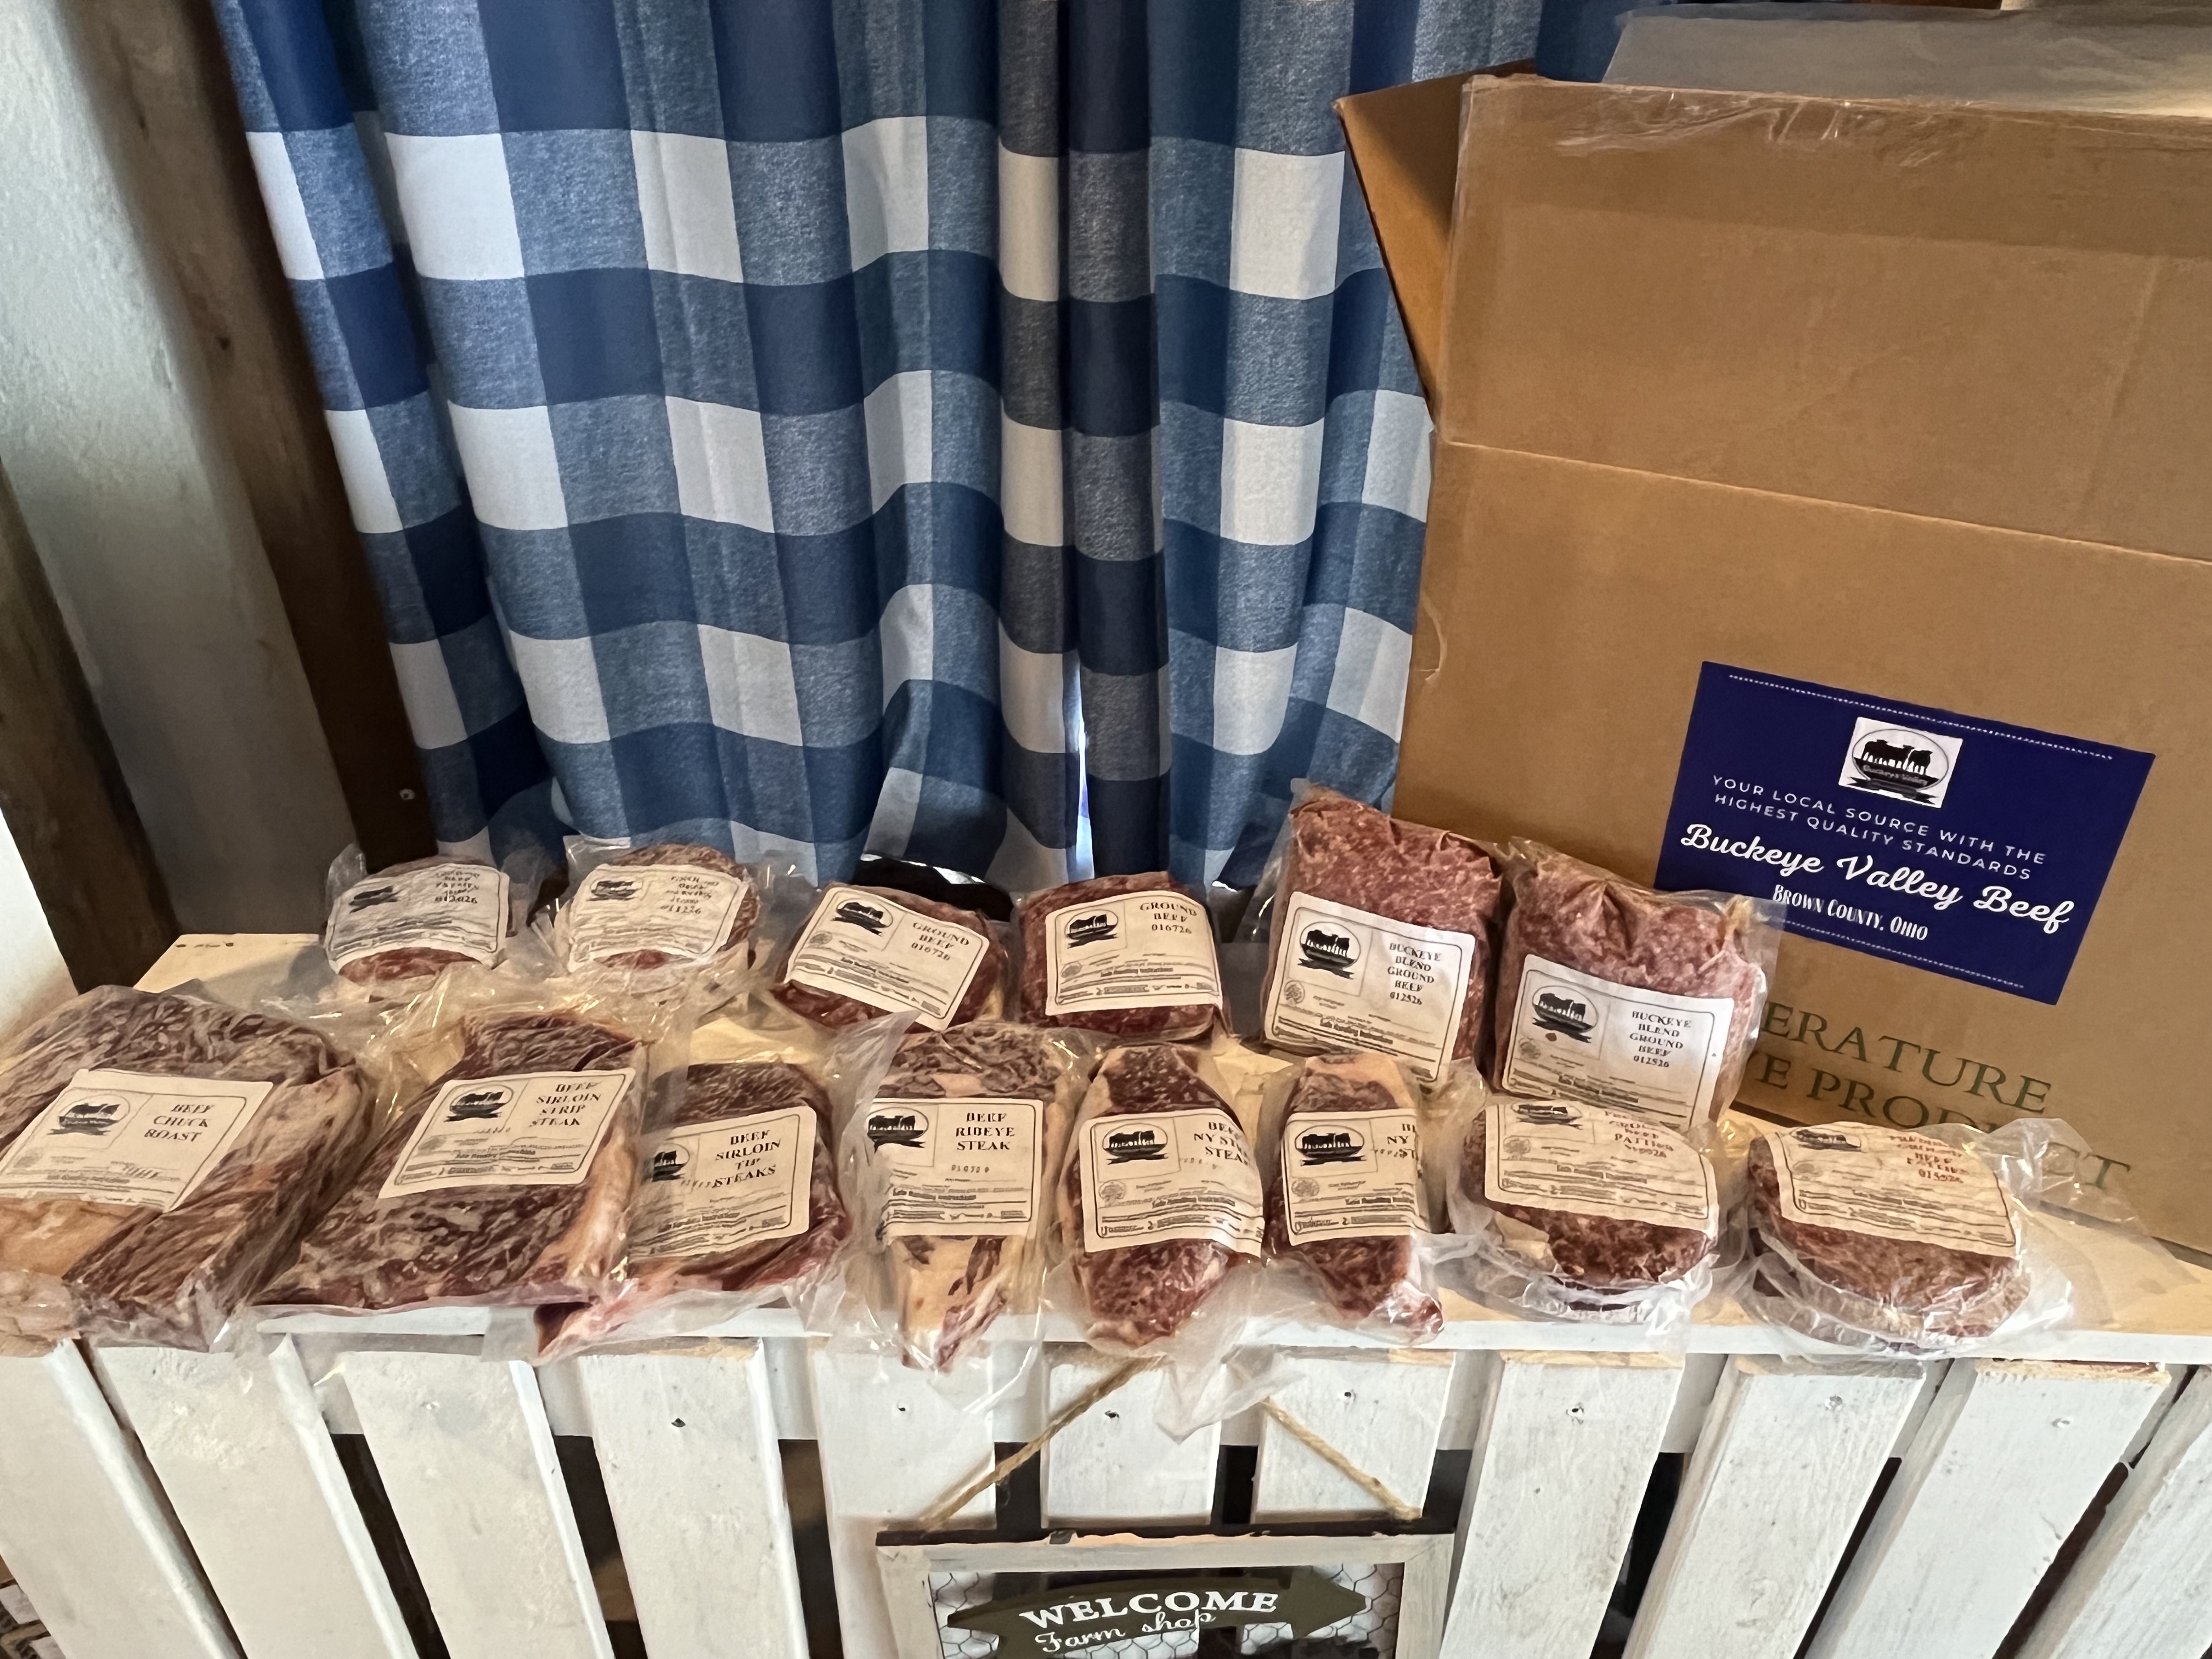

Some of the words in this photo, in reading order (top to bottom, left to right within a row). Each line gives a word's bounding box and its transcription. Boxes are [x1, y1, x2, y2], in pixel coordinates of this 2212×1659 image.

[1713, 775, 1764, 795] YOUR
[1773, 791, 1835, 814] LOCAL
[1846, 808, 1929, 837] SOURCE
[1940, 830, 1994, 851] WITH
[2005, 845, 2046, 865] THE
[1714, 794, 1798, 821] HIGHEST
[1807, 816, 1893, 845] QUALITY
[1902, 840, 2031, 879] STANDARDS
[1680, 824, 1825, 877] Buckeye
[1836, 855, 1963, 910] Valley
[1973, 885, 2074, 934] Beef
[1140, 902, 1197, 916] GROUND
[913, 922, 969, 945] GROUND
[1389, 943, 1441, 961] BUCKEYE
[1396, 956, 1431, 971] BLEND
[1387, 966, 1435, 983] GROUND
[1395, 980, 1424, 992] BEEF
[1632, 1011, 1691, 1028] BUCKEYE
[1638, 1023, 1680, 1037] BLEND
[1629, 1032, 1683, 1048] GROUND
[1638, 1045, 1672, 1057] BEEF
[536, 1093, 601, 1104] SIRLOIN
[154, 1115, 209, 1127] CHUCK
[967, 1113, 1007, 1122] BEEF
[144, 1129, 202, 1142] ROAST
[731, 1130, 770, 1146] BEEF
[956, 1127, 1015, 1137] RIBEYE
[1194, 1133, 1216, 1142] NY
[1387, 1135, 1409, 1144] NY
[715, 1138, 781, 1161] SIRLOIN
[957, 1141, 1011, 1150] STEAK
[735, 1158, 761, 1170] TIP
[712, 1164, 776, 1188] STEAKS
[1019, 1591, 1278, 1628] WELCOME
[1035, 1627, 1126, 1652] Farm
[1142, 1609, 1216, 1636] shop
